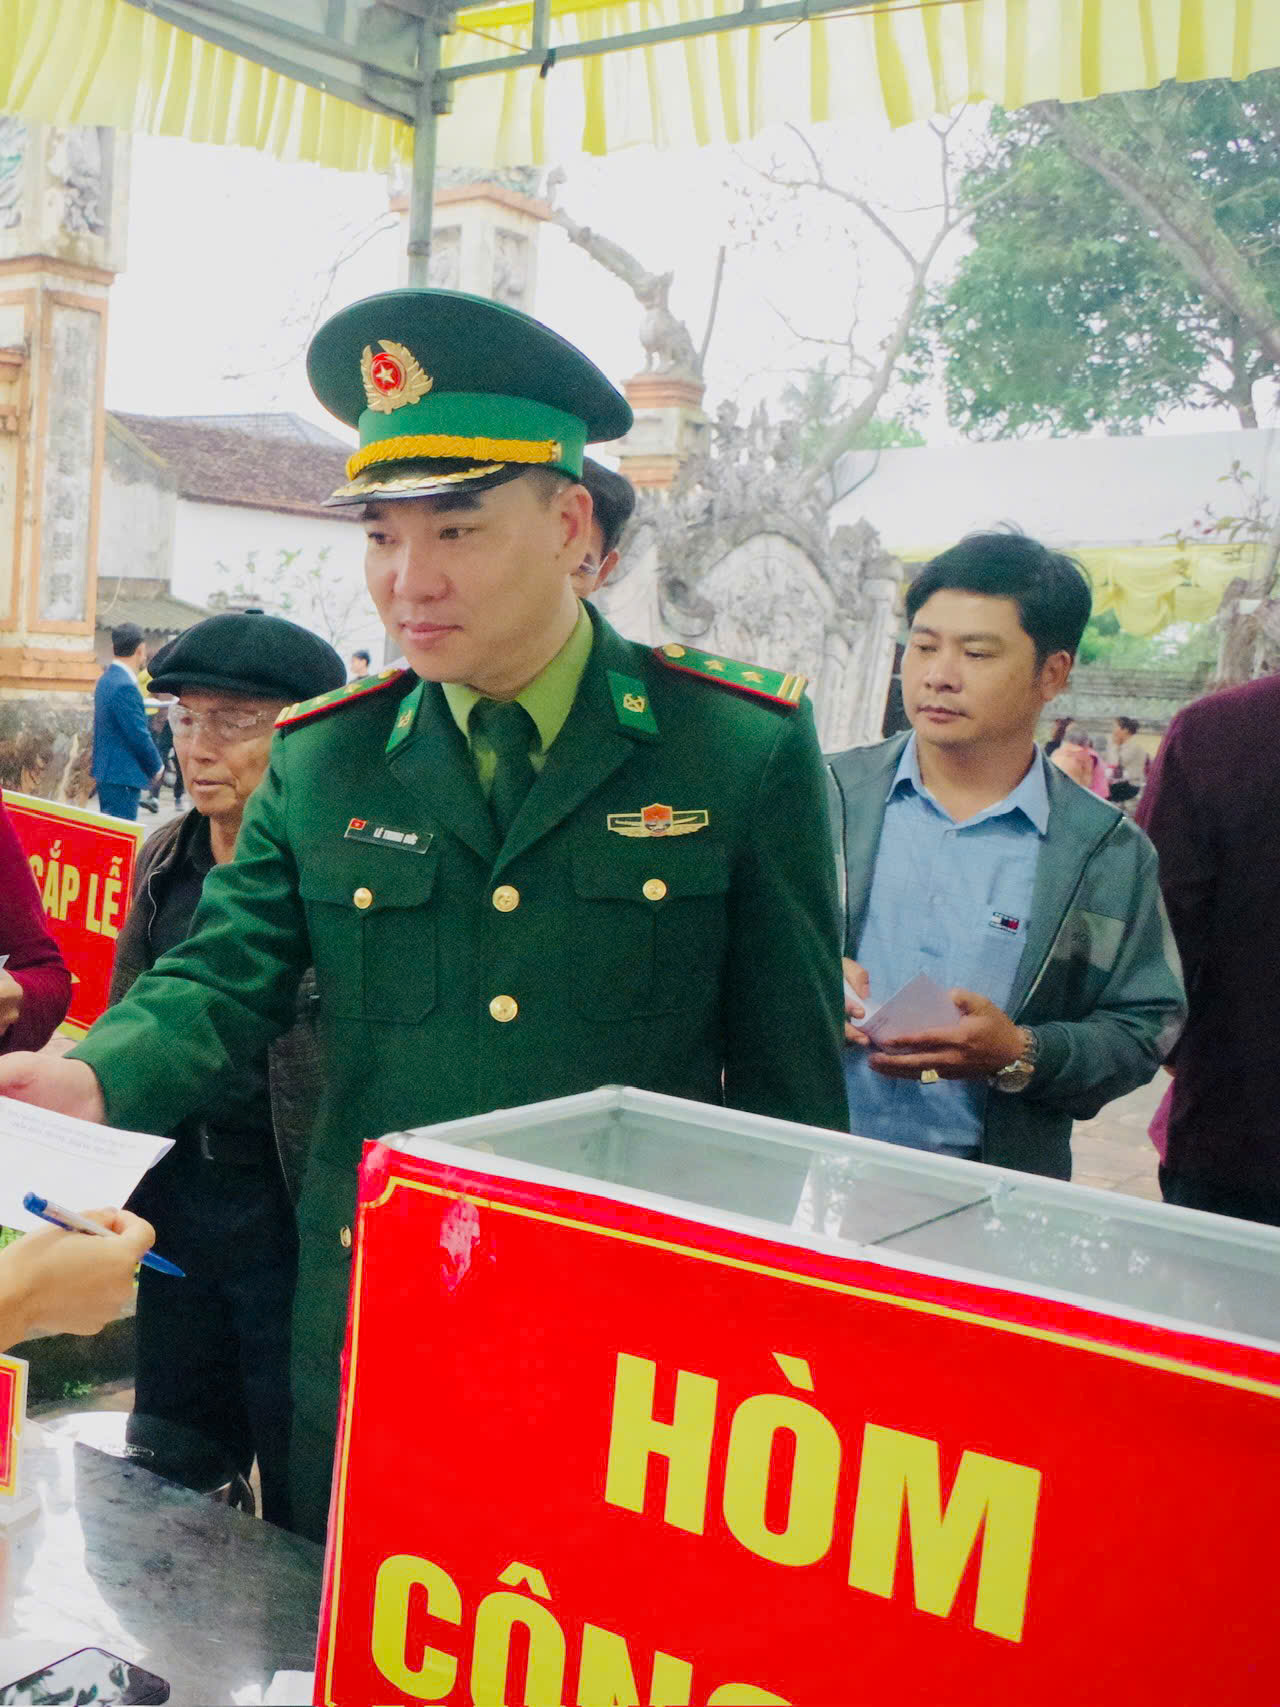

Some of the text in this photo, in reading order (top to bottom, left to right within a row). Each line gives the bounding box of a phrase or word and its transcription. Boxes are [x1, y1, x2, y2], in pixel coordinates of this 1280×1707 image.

[85, 855, 123, 940] LỄ
[605, 1352, 1042, 1642] HÒM
[372, 1555, 793, 1707] CÔN
